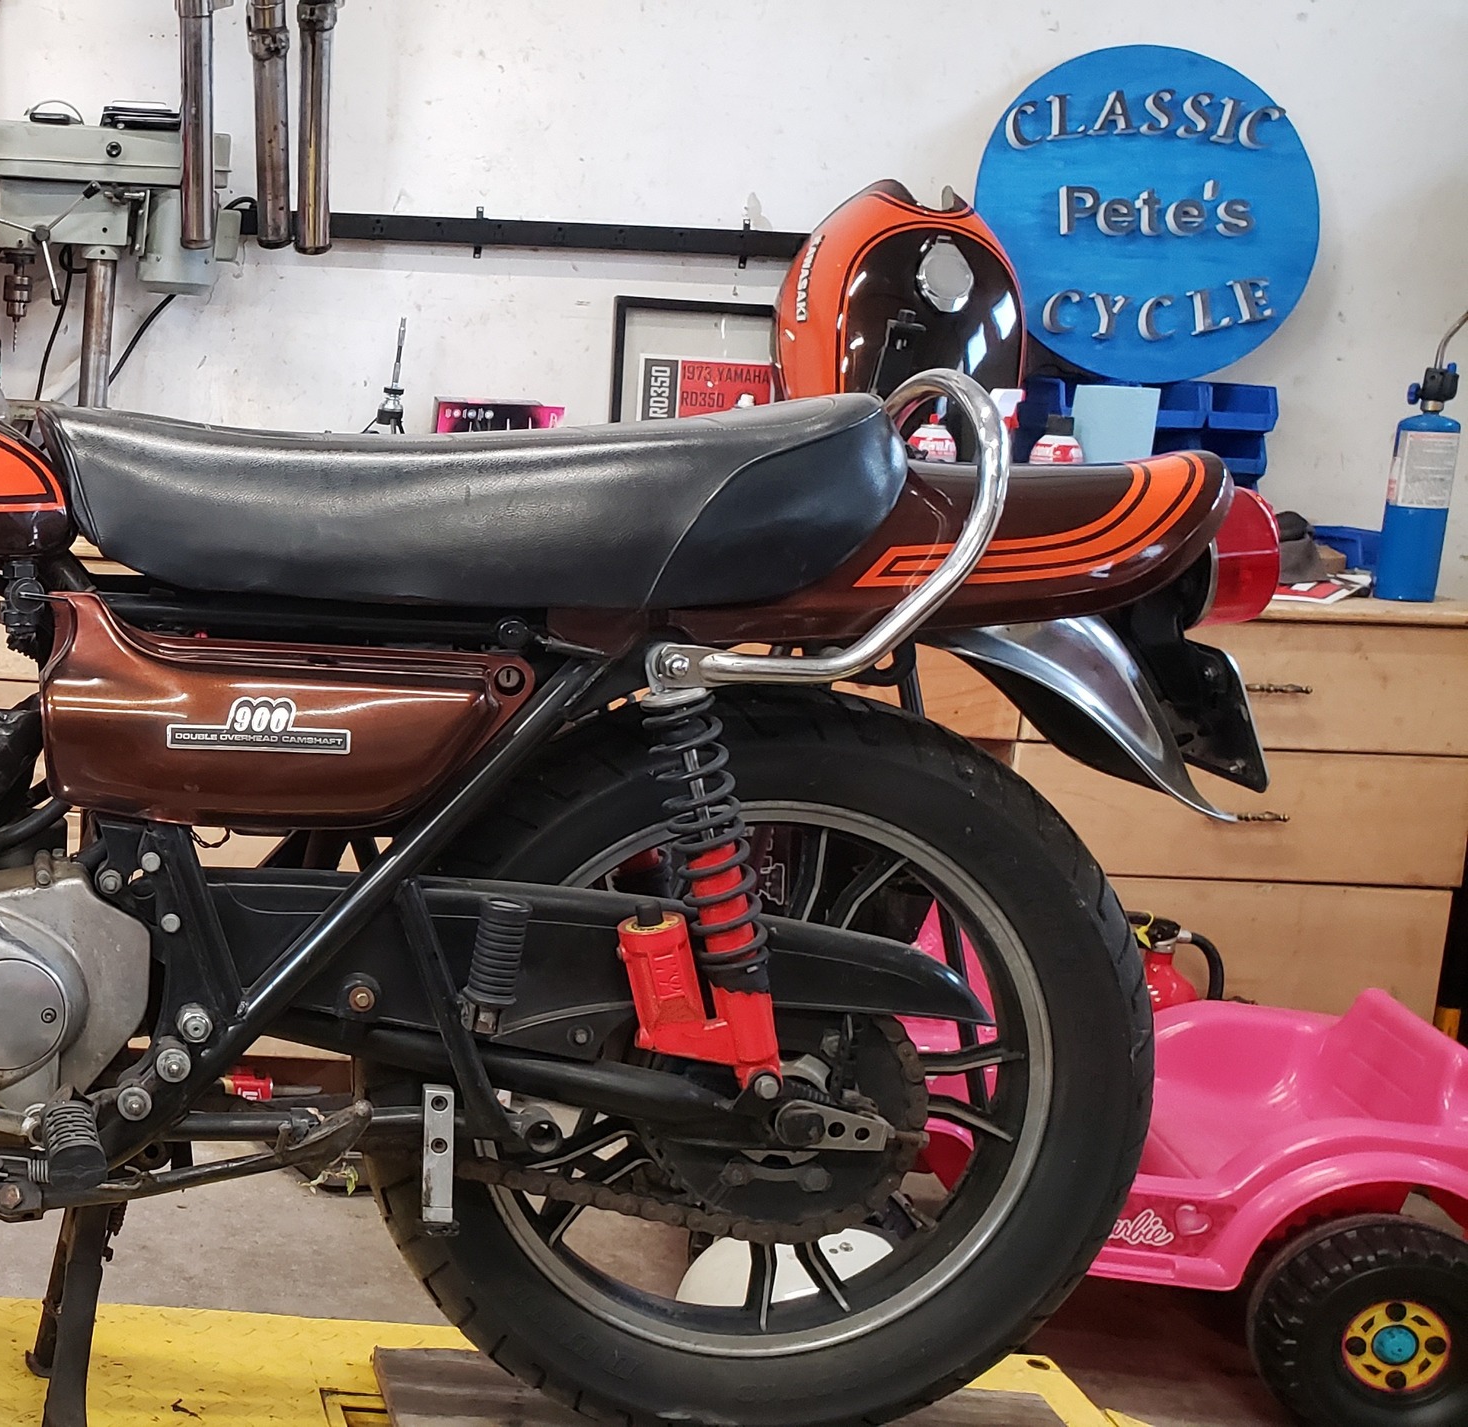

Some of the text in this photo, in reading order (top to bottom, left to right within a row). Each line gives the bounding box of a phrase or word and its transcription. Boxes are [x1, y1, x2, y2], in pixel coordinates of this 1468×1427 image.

[1005, 89, 1285, 150] CLASSIC
[1059, 179, 1254, 237] Pete's
[796, 235, 824, 322] KAWASAKI
[1042, 277, 1274, 341] CYCLE
[649, 366, 671, 418] RD350
[683, 365, 771, 385] 1973 YAMAHA
[682, 391, 725, 408] RD350
[175, 732, 343, 746] DOUBLE OVERHEAD CAMSHAFT
[233, 705, 290, 733] 900
[1108, 1208, 1175, 1247] arbie
